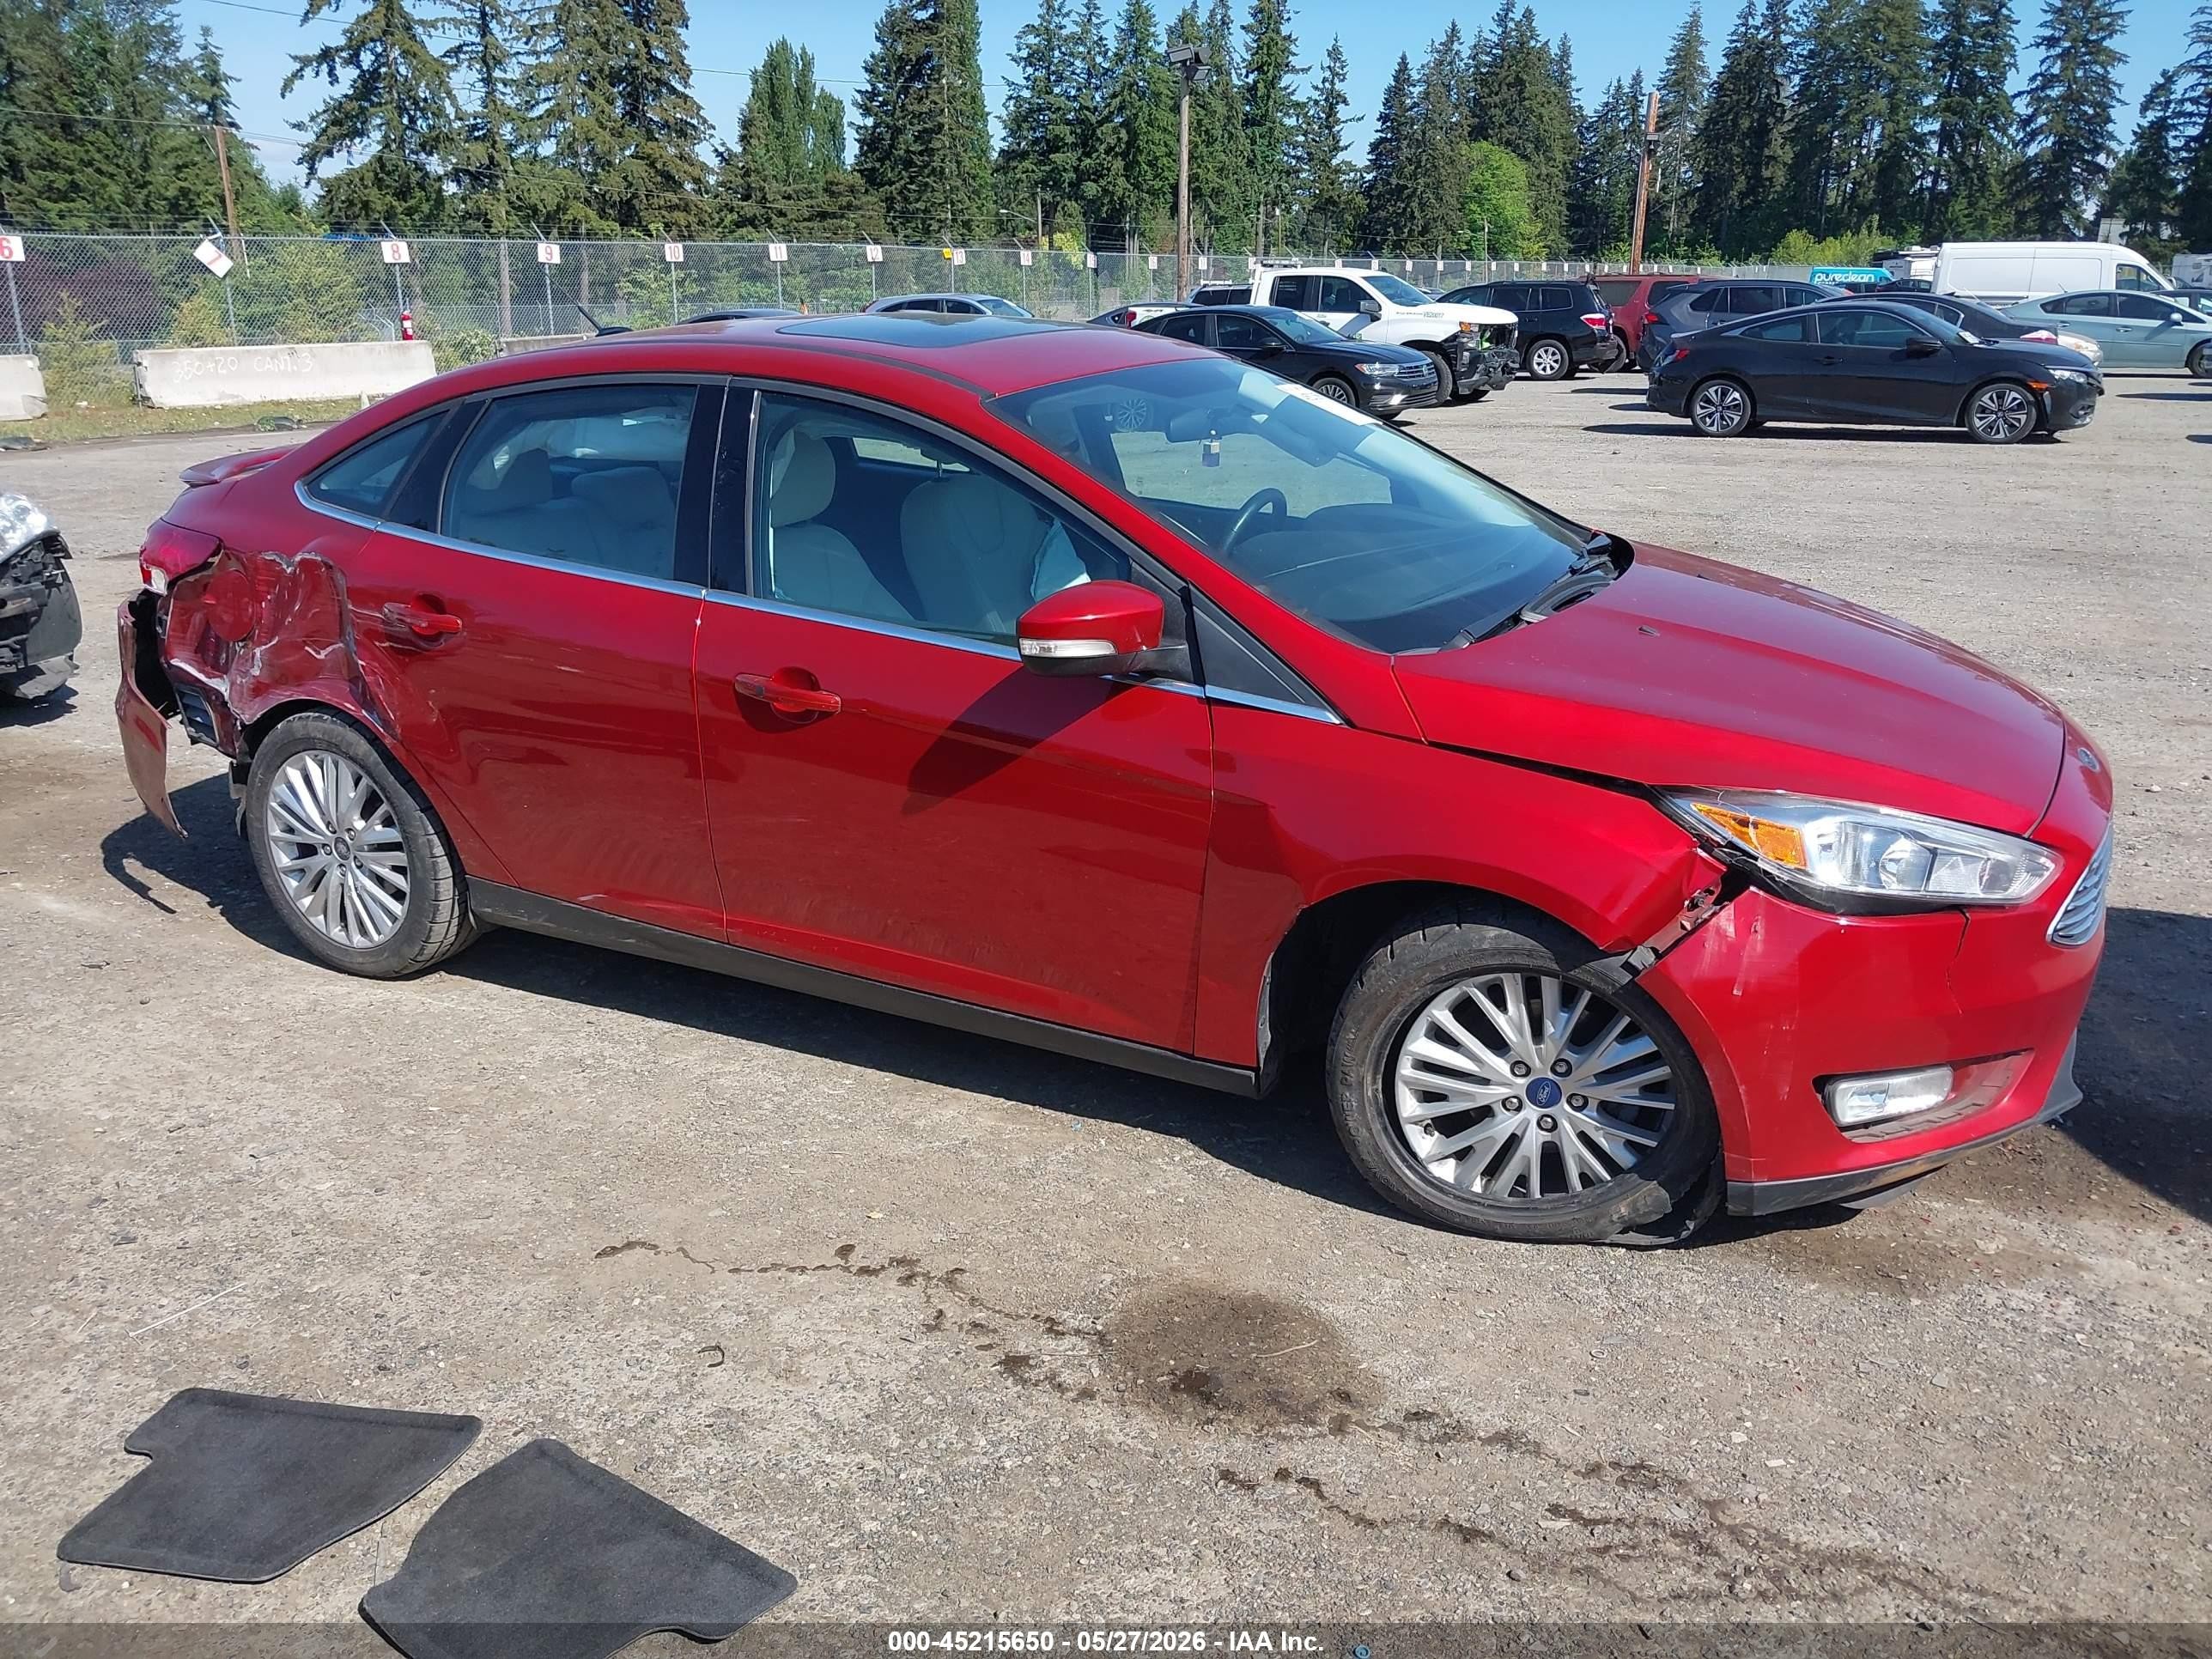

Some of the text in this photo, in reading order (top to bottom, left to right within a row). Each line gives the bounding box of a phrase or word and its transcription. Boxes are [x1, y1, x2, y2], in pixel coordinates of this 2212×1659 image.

[0, 237, 14, 259] 6
[391, 243, 402, 261] 8
[544, 245, 554, 262] 9
[668, 246, 680, 260] 10
[775, 246, 783, 259] 11
[869, 246, 880, 261] 12
[207, 250, 222, 266] 7
[956, 251, 963, 264] 13
[1024, 252, 1030, 264] 14
[1814, 270, 1875, 283] pureclean
[1537, 1084, 1550, 1103] Ford
